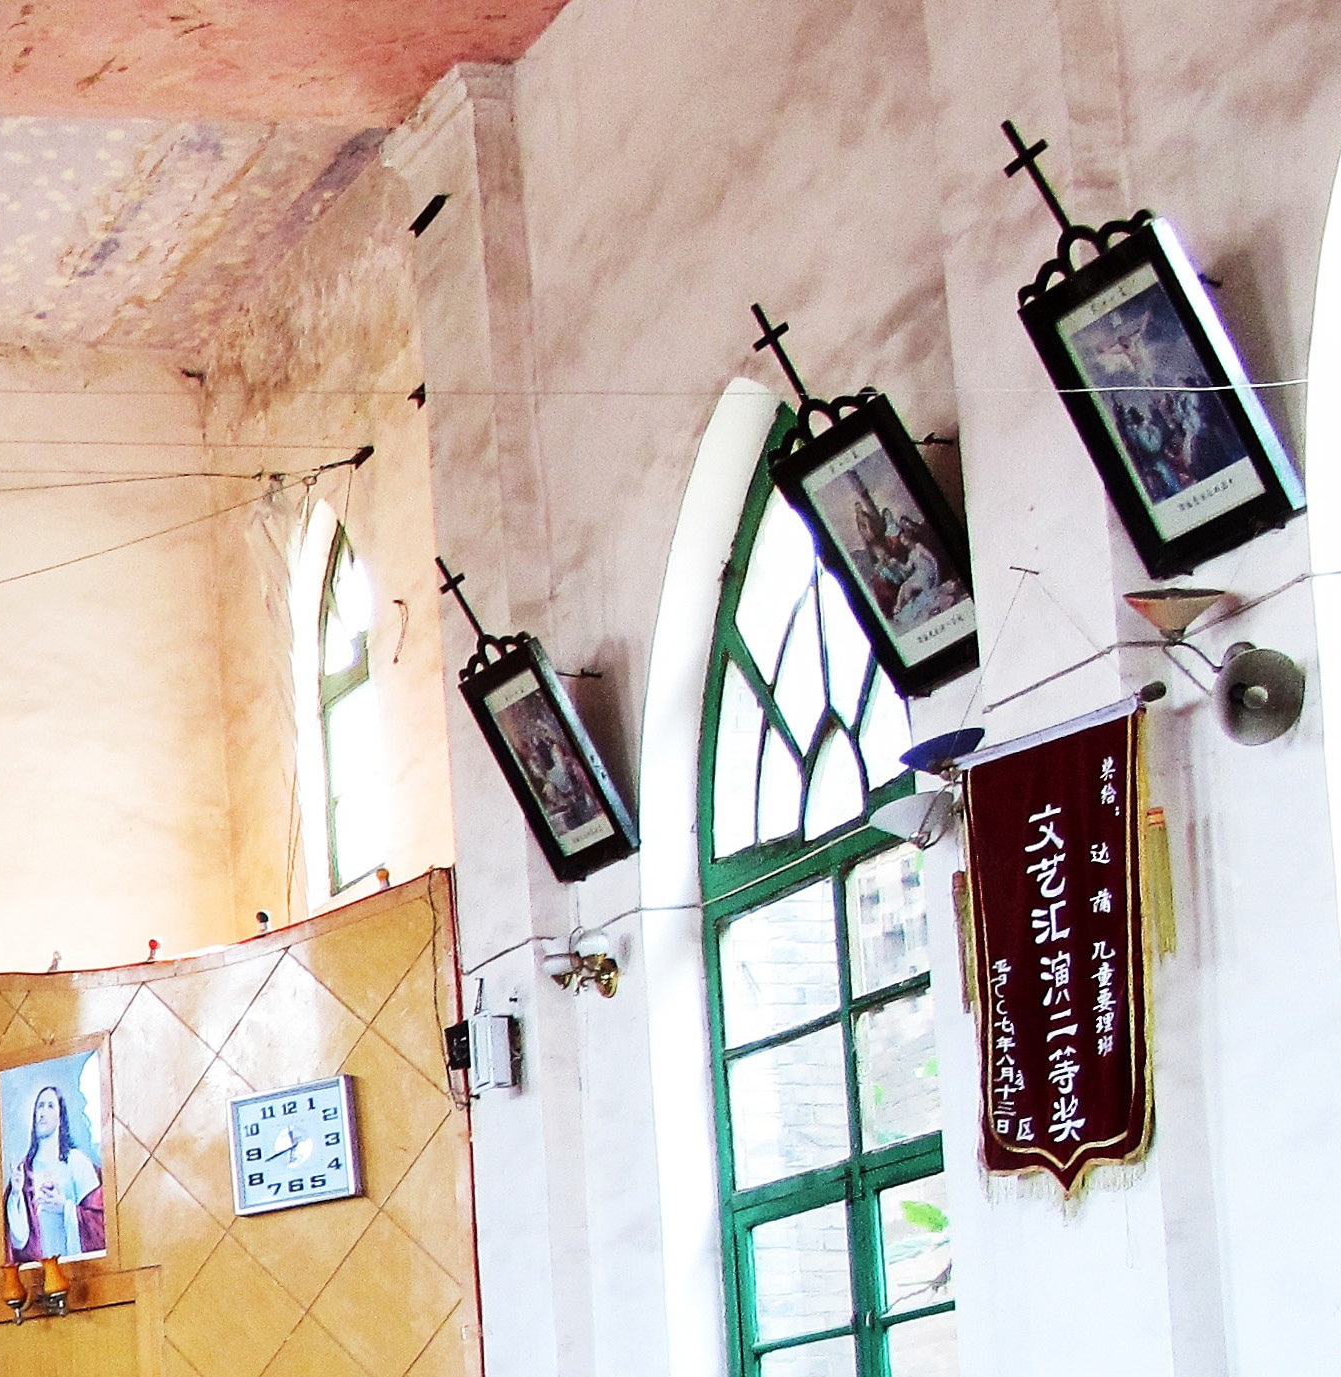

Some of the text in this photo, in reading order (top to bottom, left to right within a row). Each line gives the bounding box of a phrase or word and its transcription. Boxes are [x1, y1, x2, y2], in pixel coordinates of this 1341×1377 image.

[1024, 803, 1087, 1142] 文艺汇演二等奖
[282, 1101, 297, 1115] 12
[307, 1097, 316, 1111] 1
[261, 1106, 275, 1119] 11
[322, 1107, 338, 1121] 2
[244, 1123, 260, 1137] 10
[324, 1132, 340, 1146] 3
[246, 1148, 262, 1162] 9
[327, 1157, 343, 1170] 4
[248, 1172, 264, 1187] 8
[288, 1179, 304, 1193] 6
[310, 1174, 327, 1188] 5
[267, 1183, 282, 1196] 7
